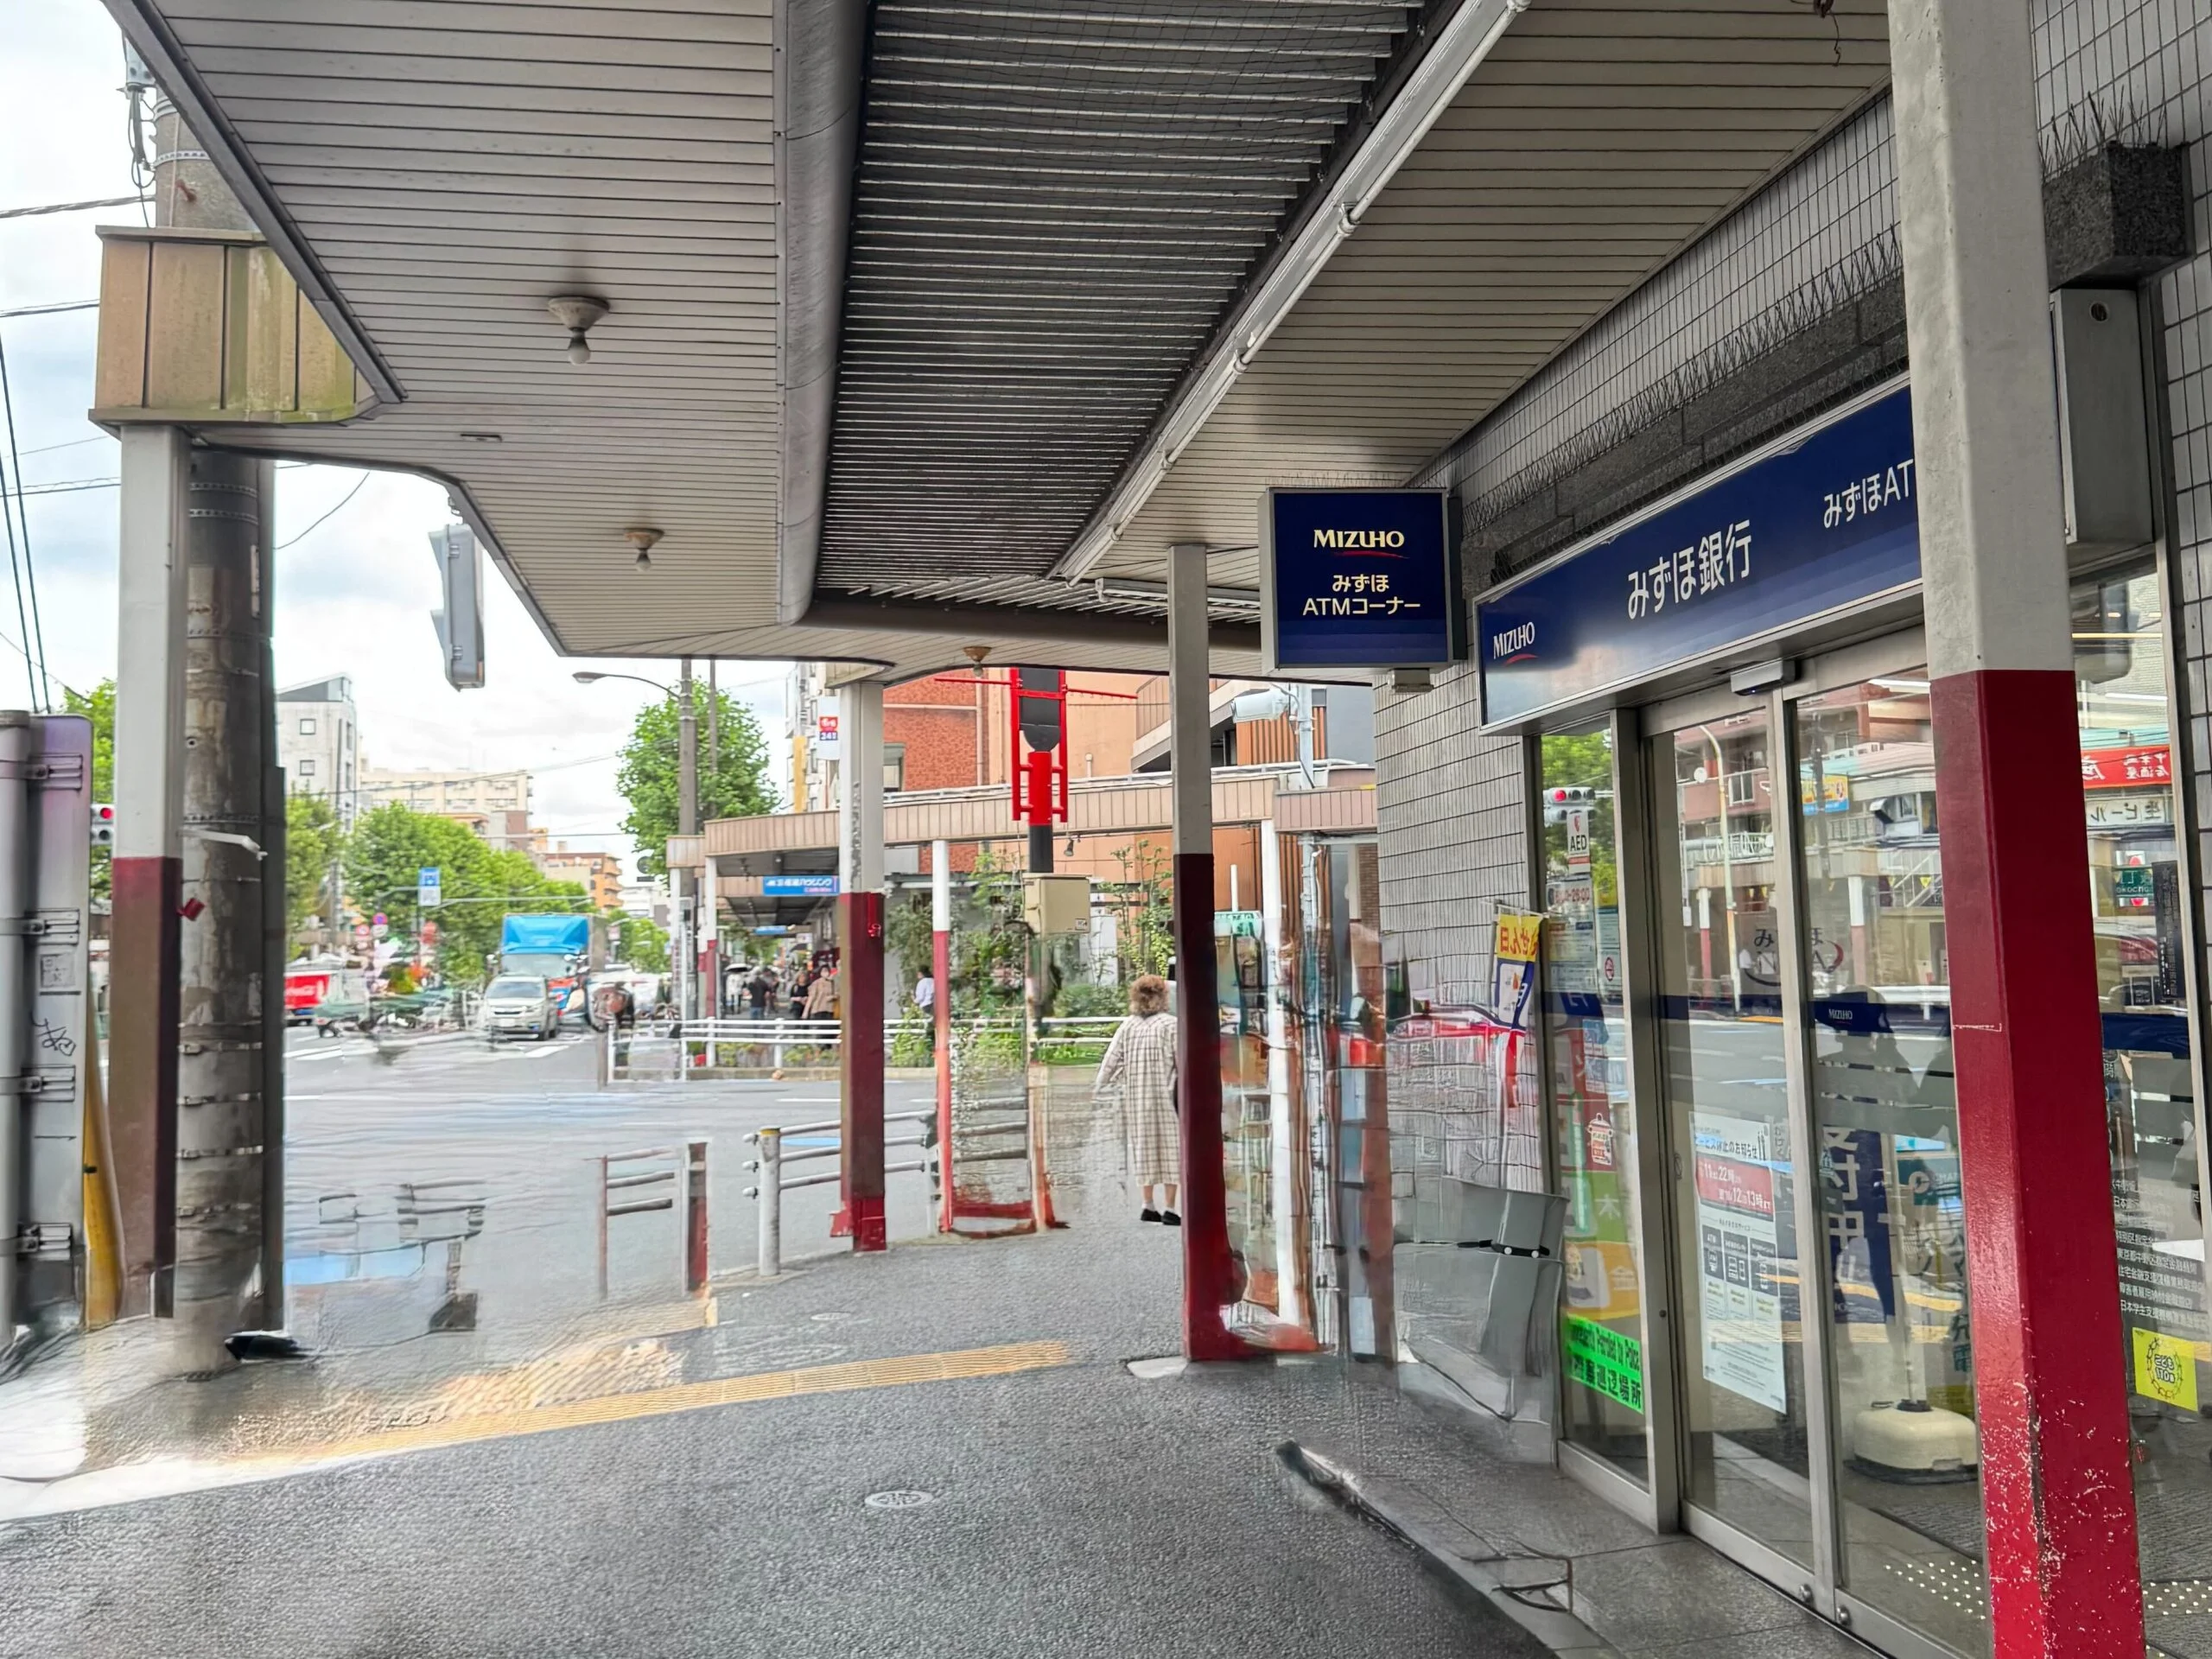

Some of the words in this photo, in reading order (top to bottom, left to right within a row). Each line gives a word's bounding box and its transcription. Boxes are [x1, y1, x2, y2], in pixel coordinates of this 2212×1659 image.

[1823, 458, 1914, 529] みずほAT
[1313, 529, 1405, 549] MIZUHO
[1628, 518, 1752, 620] みずほ銀行
[1332, 574, 1390, 593] みずほ
[1302, 596, 1421, 616] ATMコーナー
[1493, 621, 1535, 660] MIZUHO
[1569, 835, 1588, 852] AED
[1828, 1007, 1853, 1020] MIZUHO
